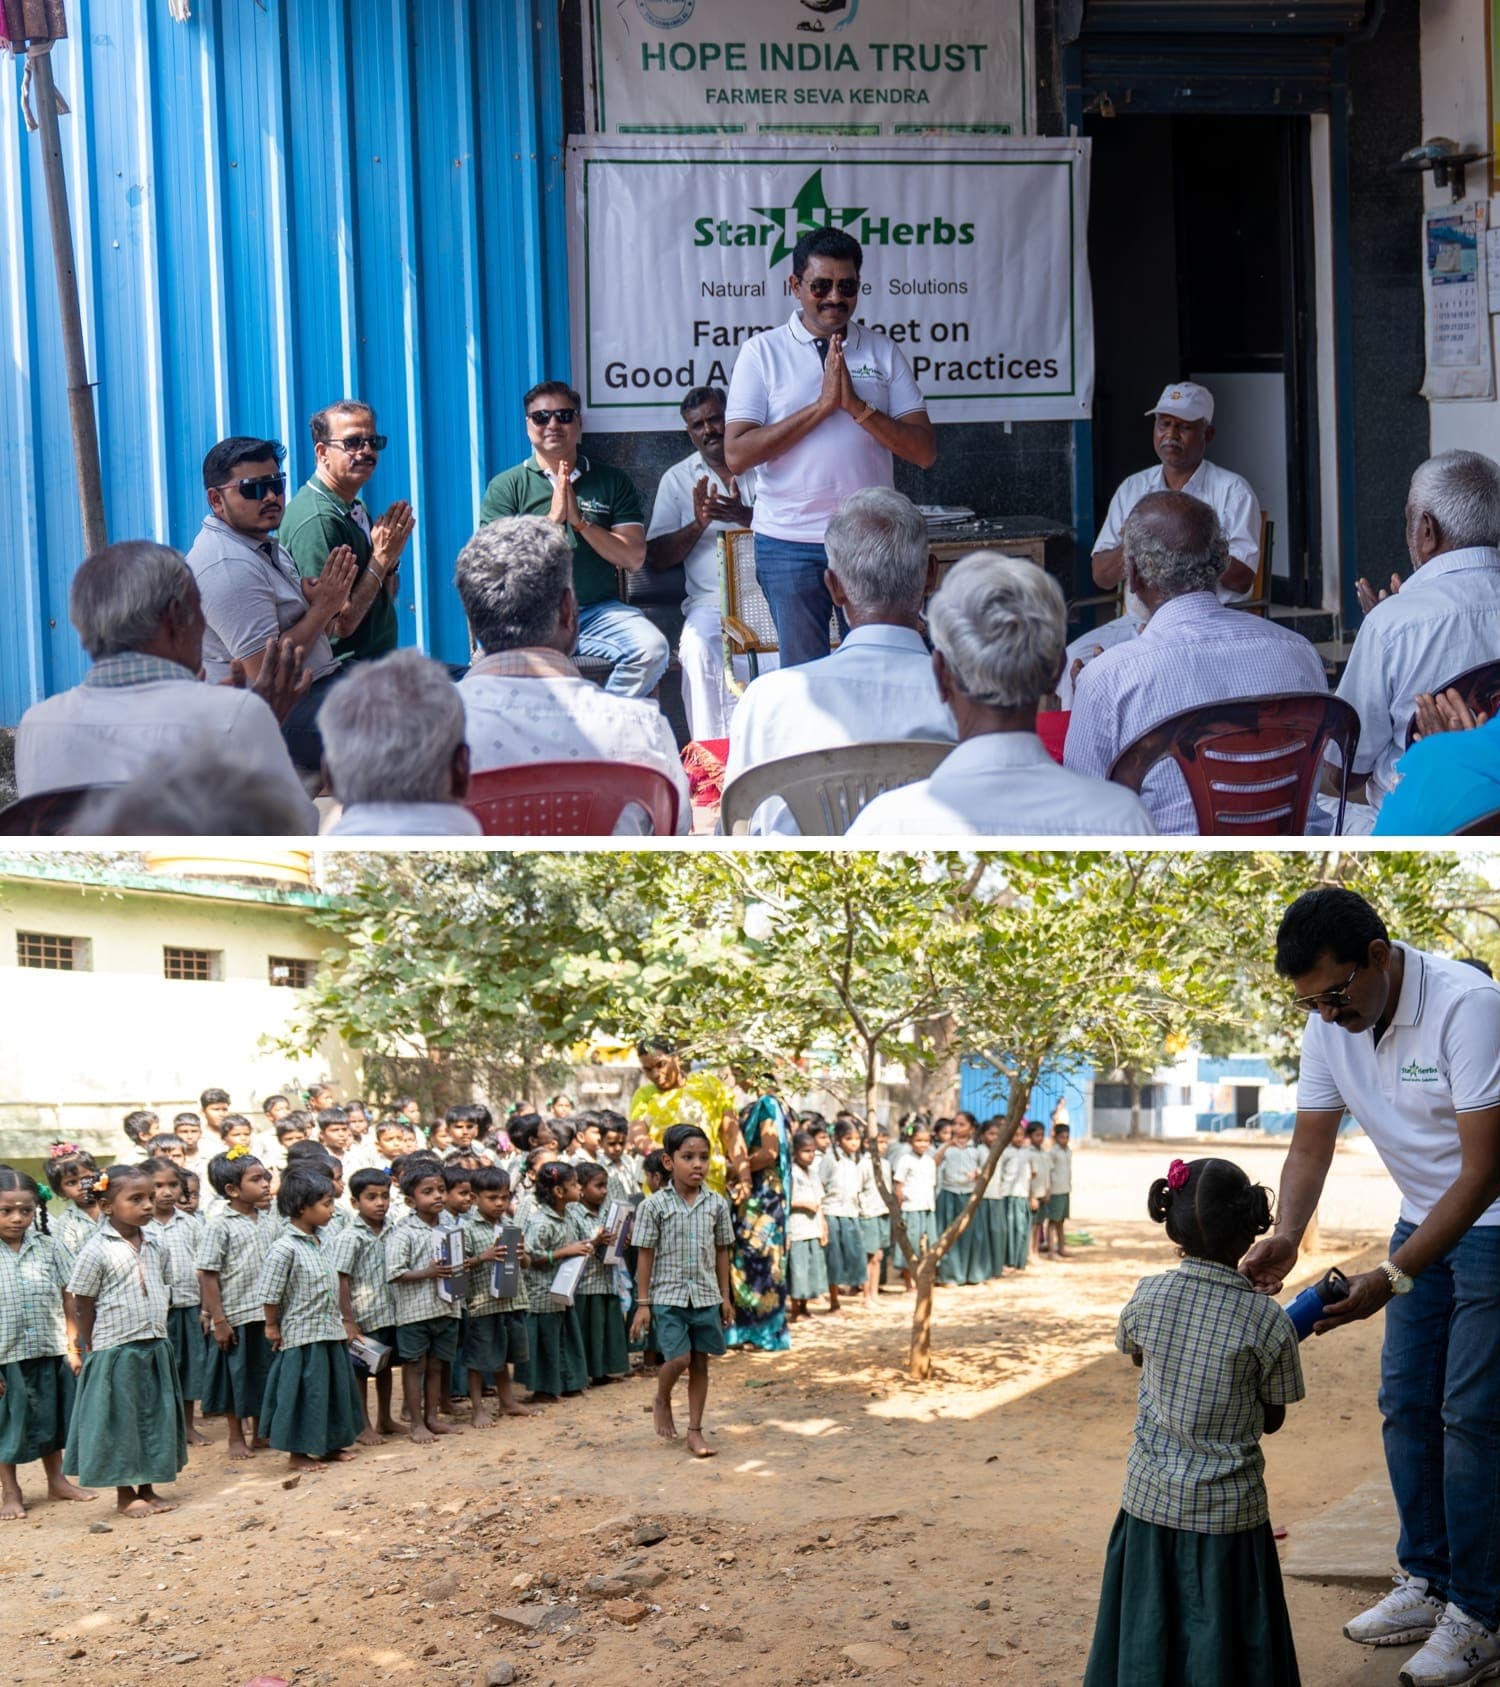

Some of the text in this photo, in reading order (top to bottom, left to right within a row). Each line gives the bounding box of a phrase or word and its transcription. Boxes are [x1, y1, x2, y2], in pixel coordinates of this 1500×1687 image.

[641, 42, 988, 72] HOPE INDIA TRUST
[705, 88, 930, 105] FARMER SEVA KENDRA
[694, 217, 775, 247] Star
[861, 216, 975, 246] Herbs
[701, 280, 765, 297] Natural
[888, 278, 968, 296] Solutions
[930, 321, 969, 343] on
[604, 360, 695, 388] Good
[913, 353, 1058, 382] Practices
